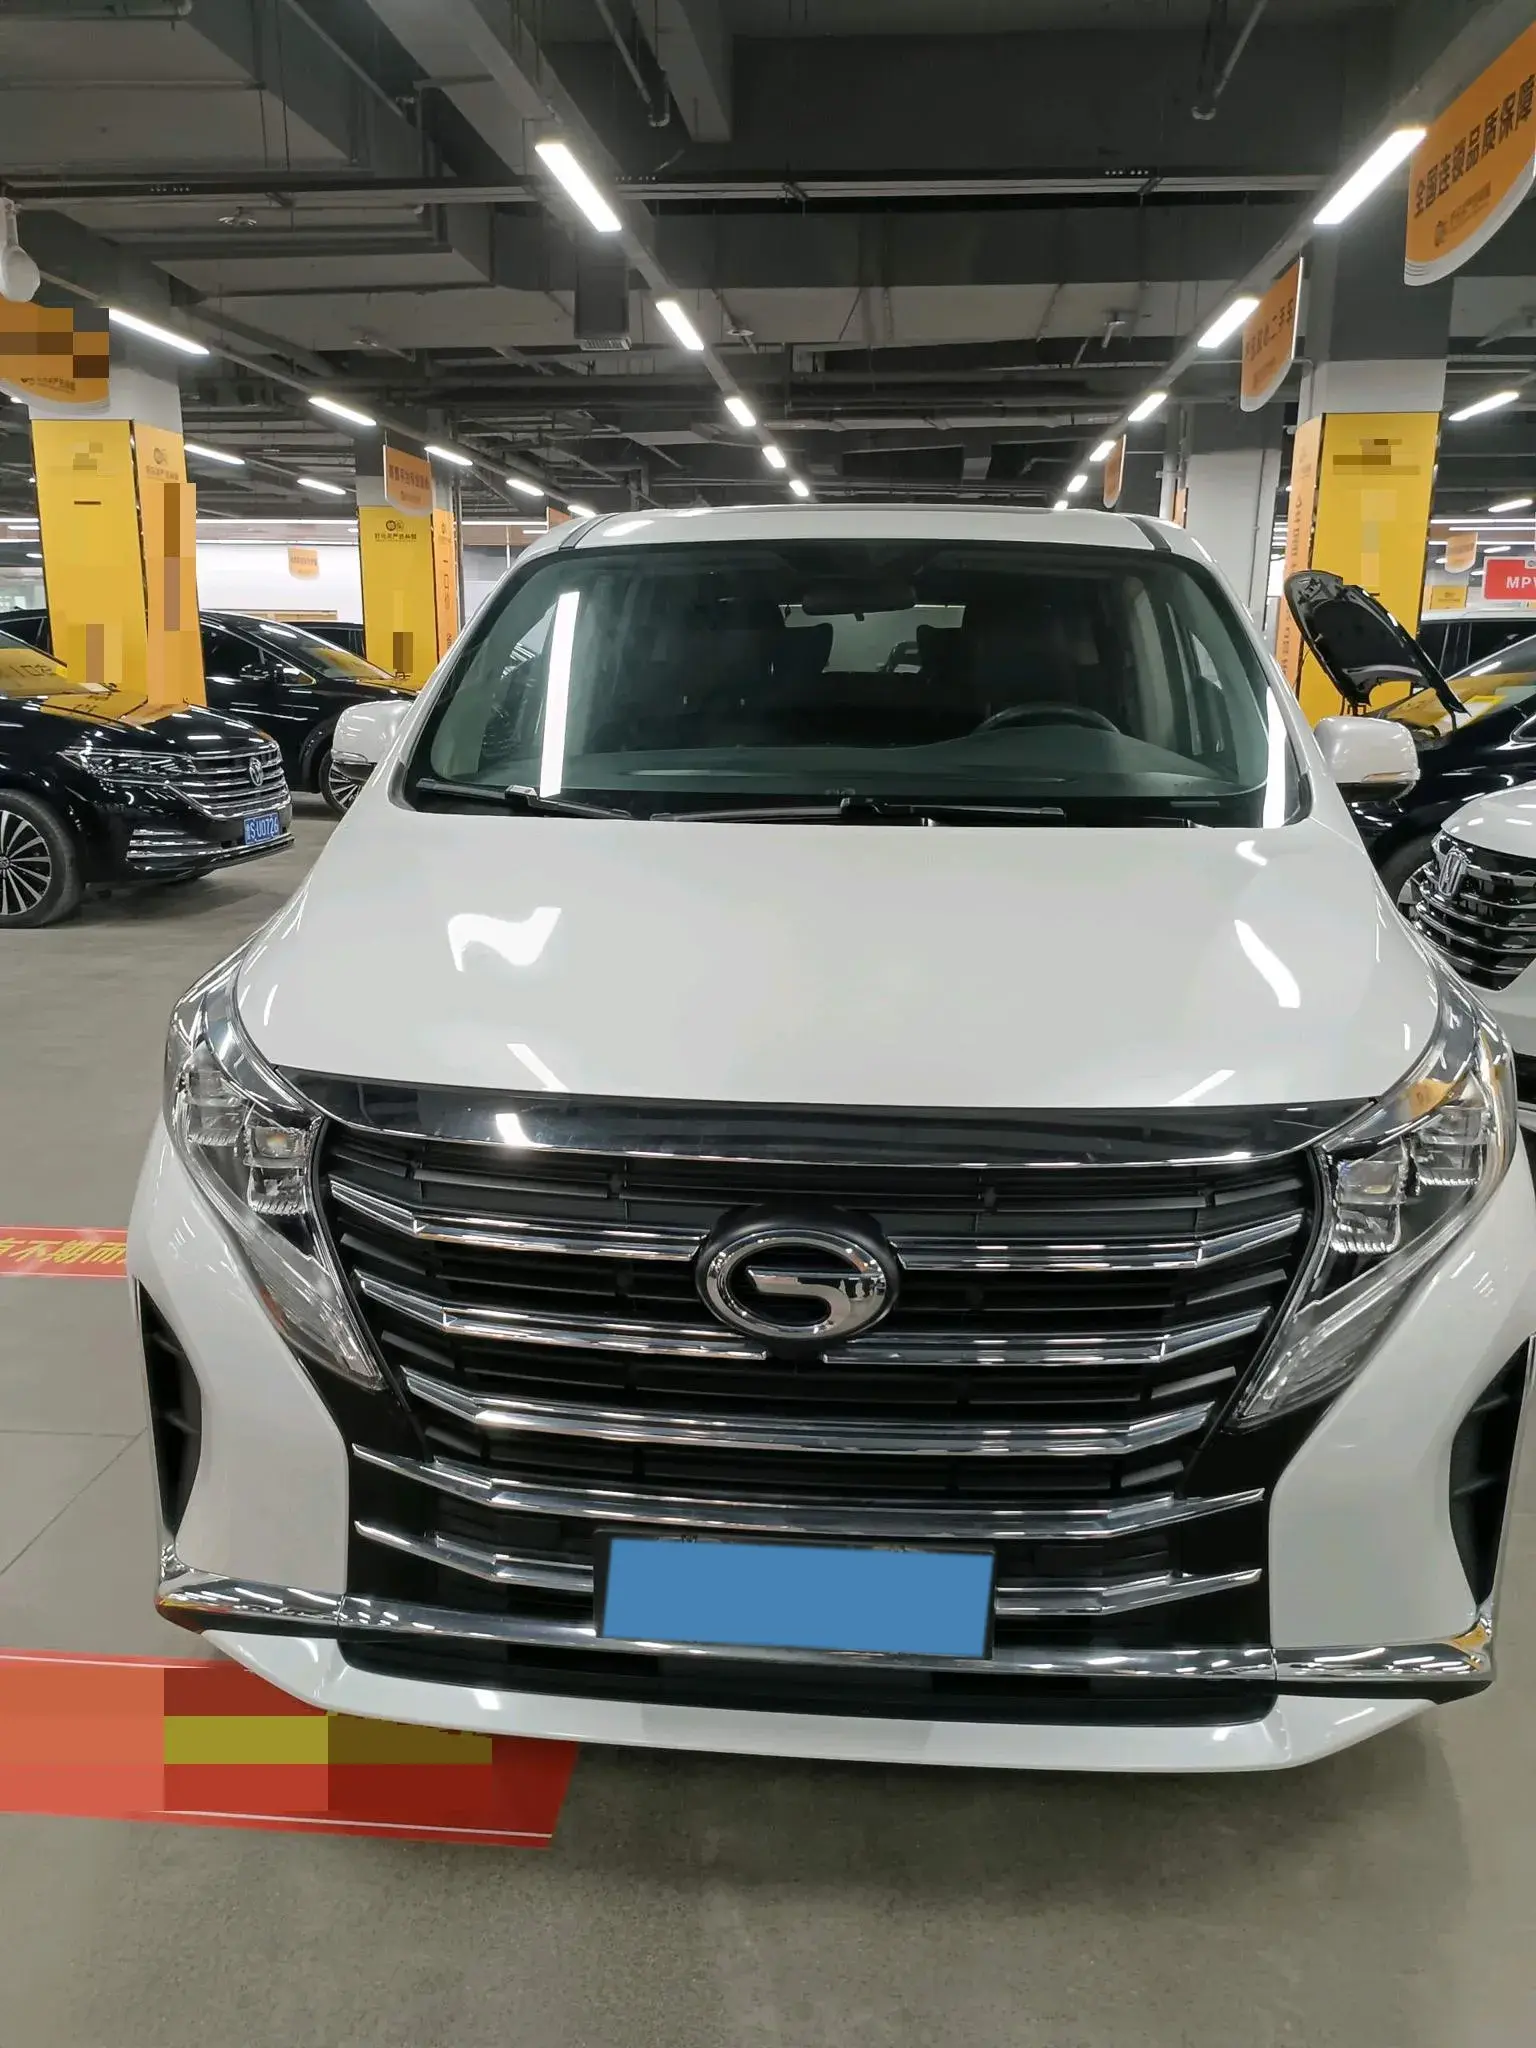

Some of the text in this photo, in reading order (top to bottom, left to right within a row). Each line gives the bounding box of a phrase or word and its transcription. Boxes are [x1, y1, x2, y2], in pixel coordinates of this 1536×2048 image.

[1413, 73, 1536, 220] 全国连锁品质保障
